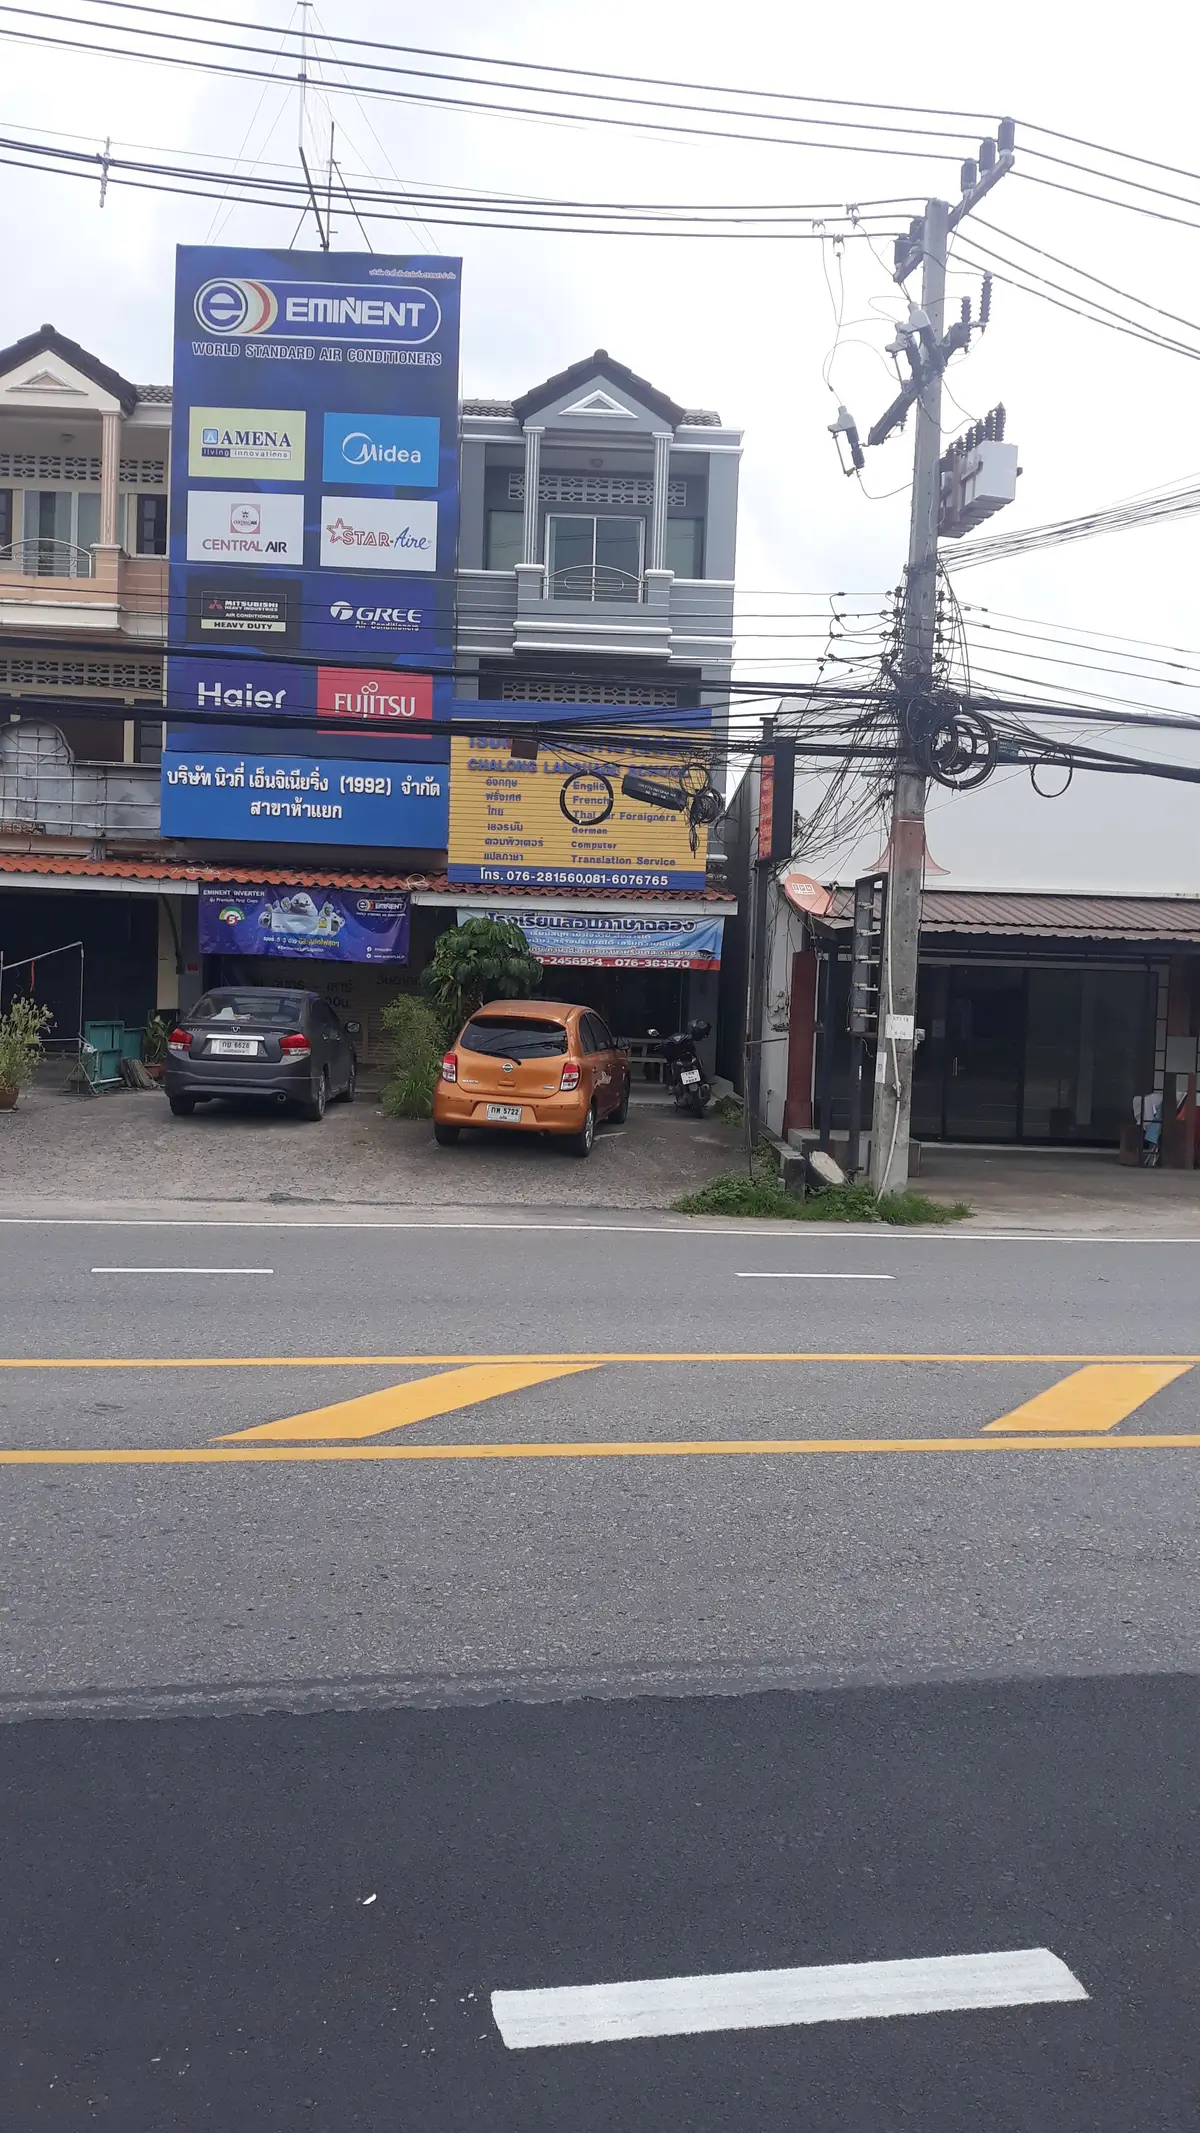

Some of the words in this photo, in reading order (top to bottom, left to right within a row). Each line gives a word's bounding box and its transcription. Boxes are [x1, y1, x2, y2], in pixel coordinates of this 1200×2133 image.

[192, 342, 240, 357] WORLD
[245, 345, 314, 360] STANDARD
[319, 347, 342, 361] AIR
[347, 349, 442, 366] CONDITIONERS
[220, 430, 291, 447] AMENA
[203, 448, 229, 457] living
[234, 449, 288, 458] innovations
[350, 438, 421, 464] Midea
[342, 526, 431, 550] STAR-Aire
[202, 539, 263, 552] CENTRAL
[265, 541, 287, 553] AIR
[225, 600, 278, 608] MITSUBISHI
[356, 607, 423, 623] GREE
[371, 621, 419, 631] Conditioners
[198, 682, 286, 709] Haier
[334, 683, 416, 719] FUJITSU
[468, 758, 537, 773] CHALONG
[167, 764, 211, 786] บริษัท
[249, 767, 328, 791] เอ็นจิเนียริ่ง
[340, 775, 391, 796] (1992)
[401, 775, 440, 796] จำกัด
[573, 781, 607, 791] Englis
[250, 796, 342, 819] สาขาห้าแยก
[620, 812, 677, 823] Foreigners
[572, 826, 608, 834] German
[571, 841, 617, 850] Computer
[571, 855, 631, 865] Translation
[636, 856, 676, 866] Service
[480, 866, 504, 881] โทร.
[506, 870, 669, 886] 076-281560,081-6076765
[503, 1108, 519, 1116] 5722
